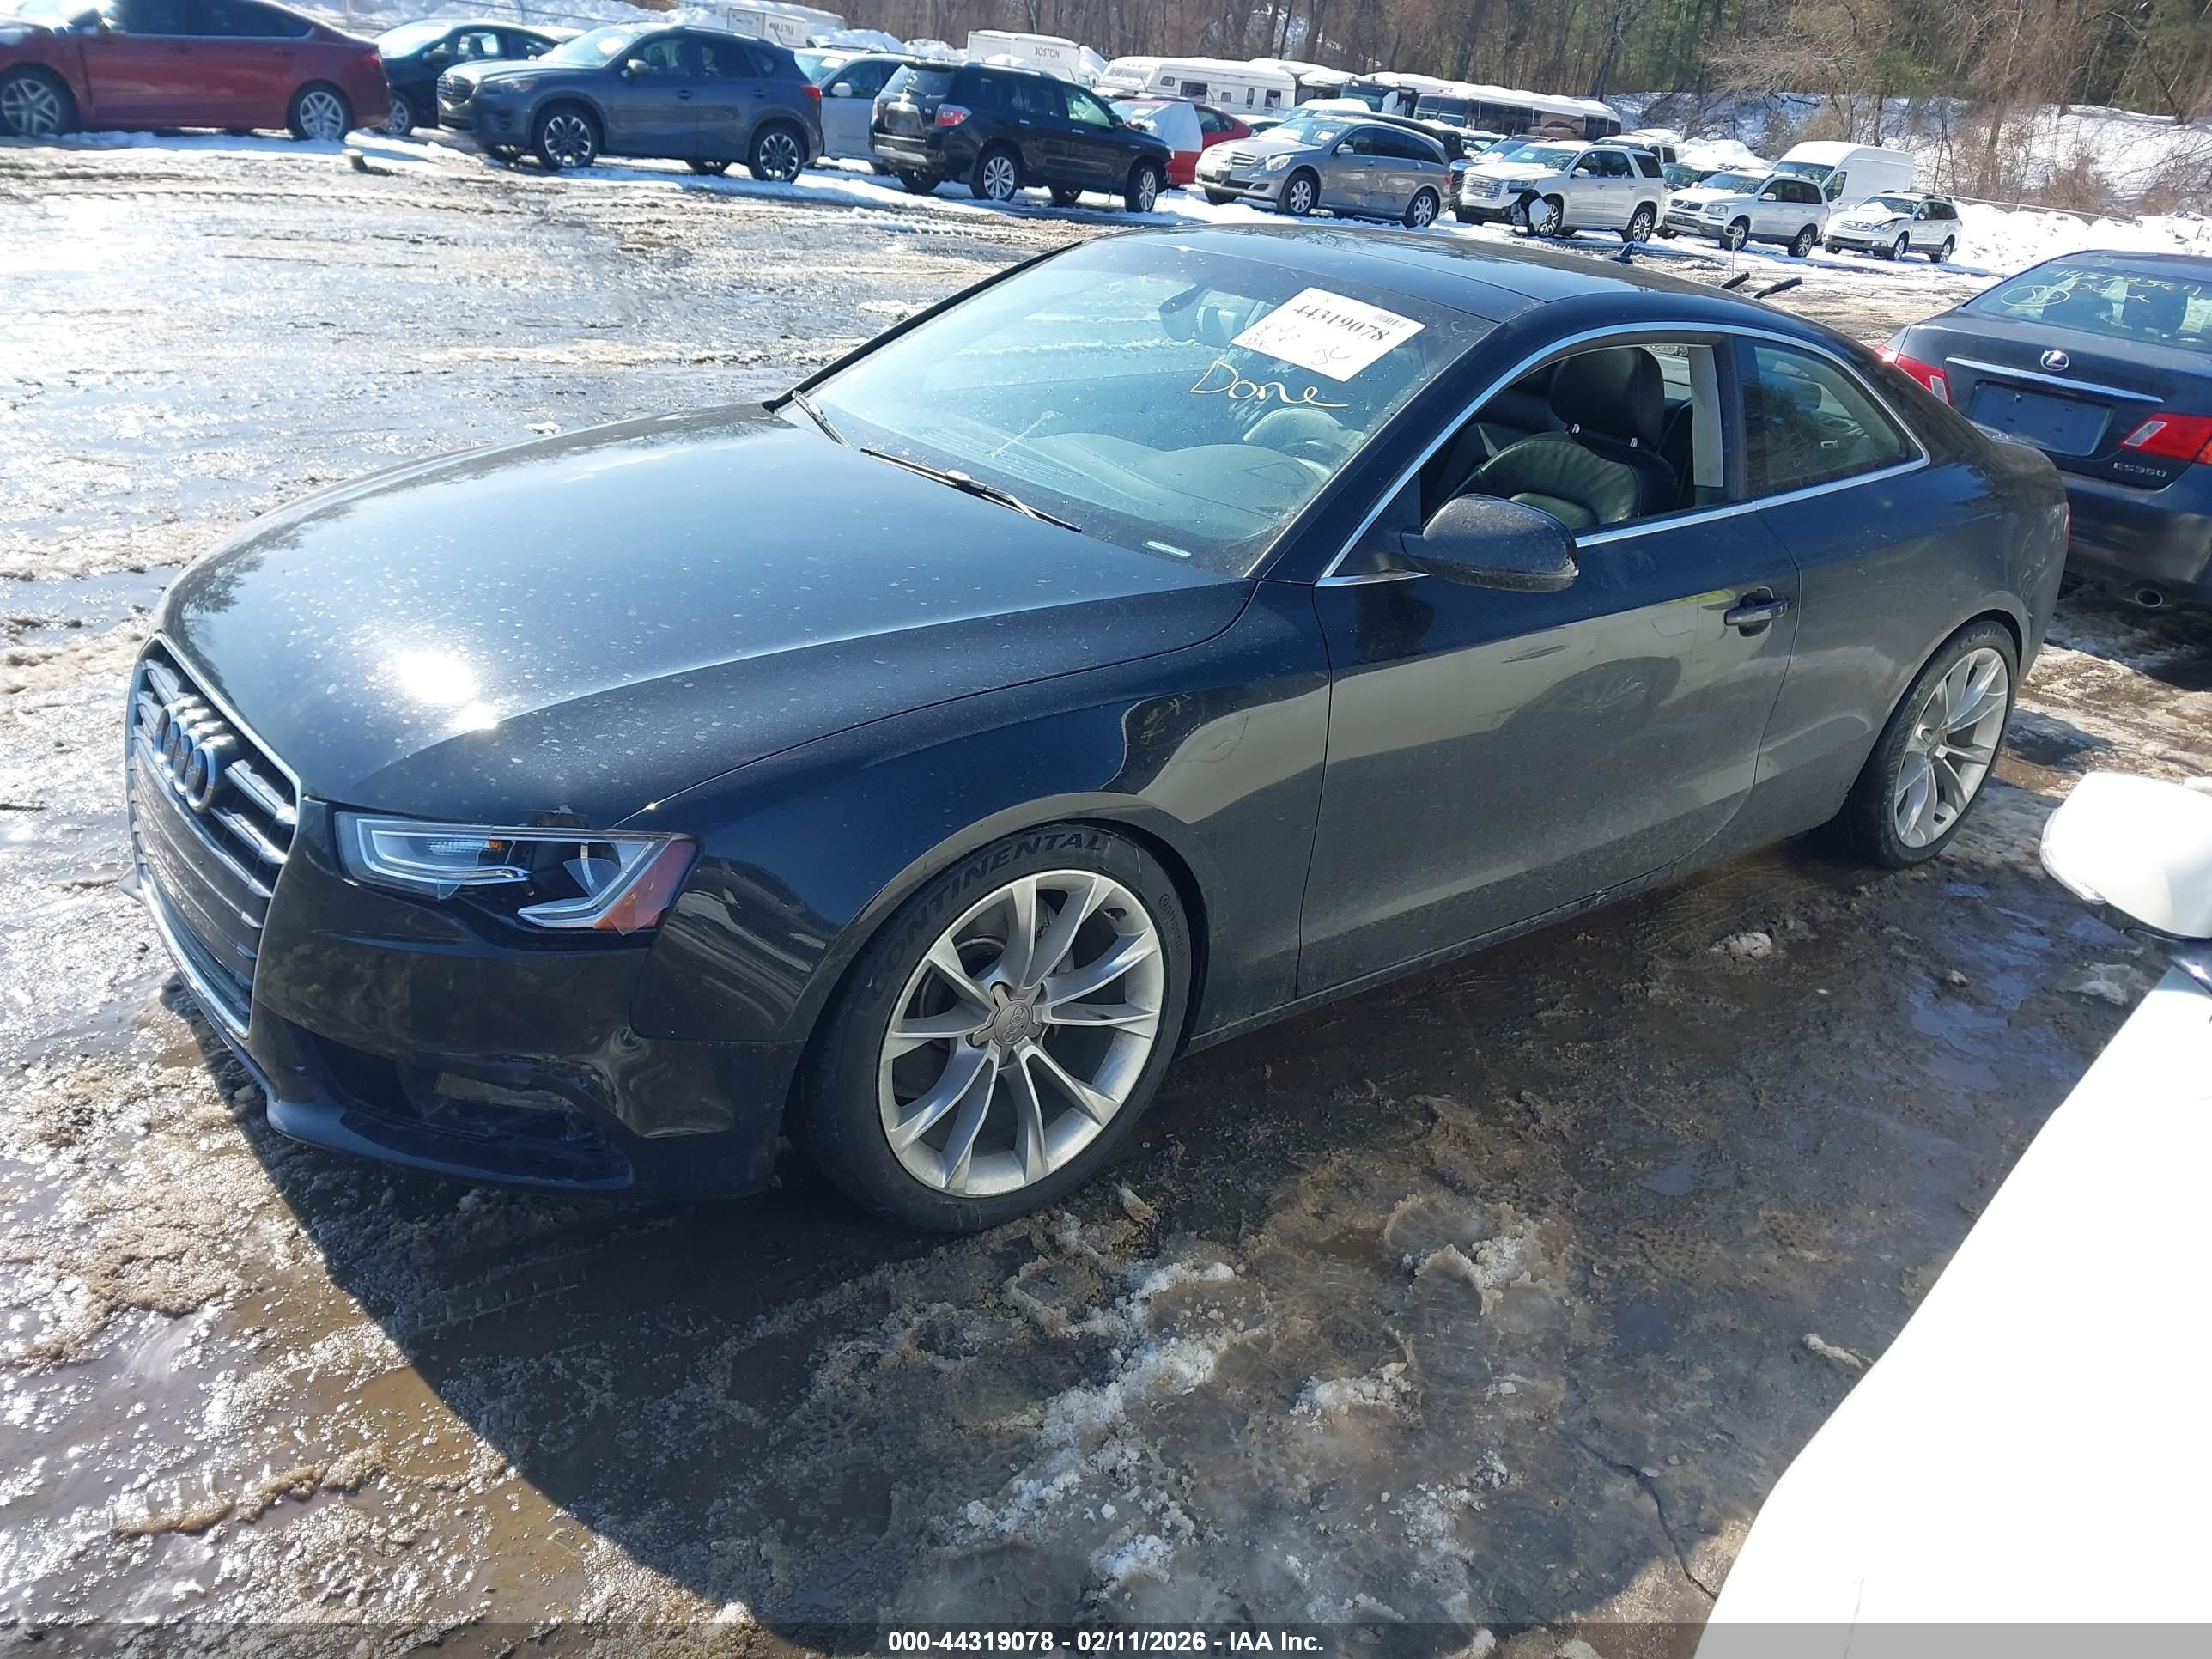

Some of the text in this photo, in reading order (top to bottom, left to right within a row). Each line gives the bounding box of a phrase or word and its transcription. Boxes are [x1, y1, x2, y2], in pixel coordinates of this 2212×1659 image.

[1034, 46, 1060, 59] BOSTON
[2065, 281, 2151, 303] Doe
[1292, 304, 1390, 342] 44319078
[1189, 360, 1350, 408] Done
[866, 830, 1104, 1001] CONTINENTAL
